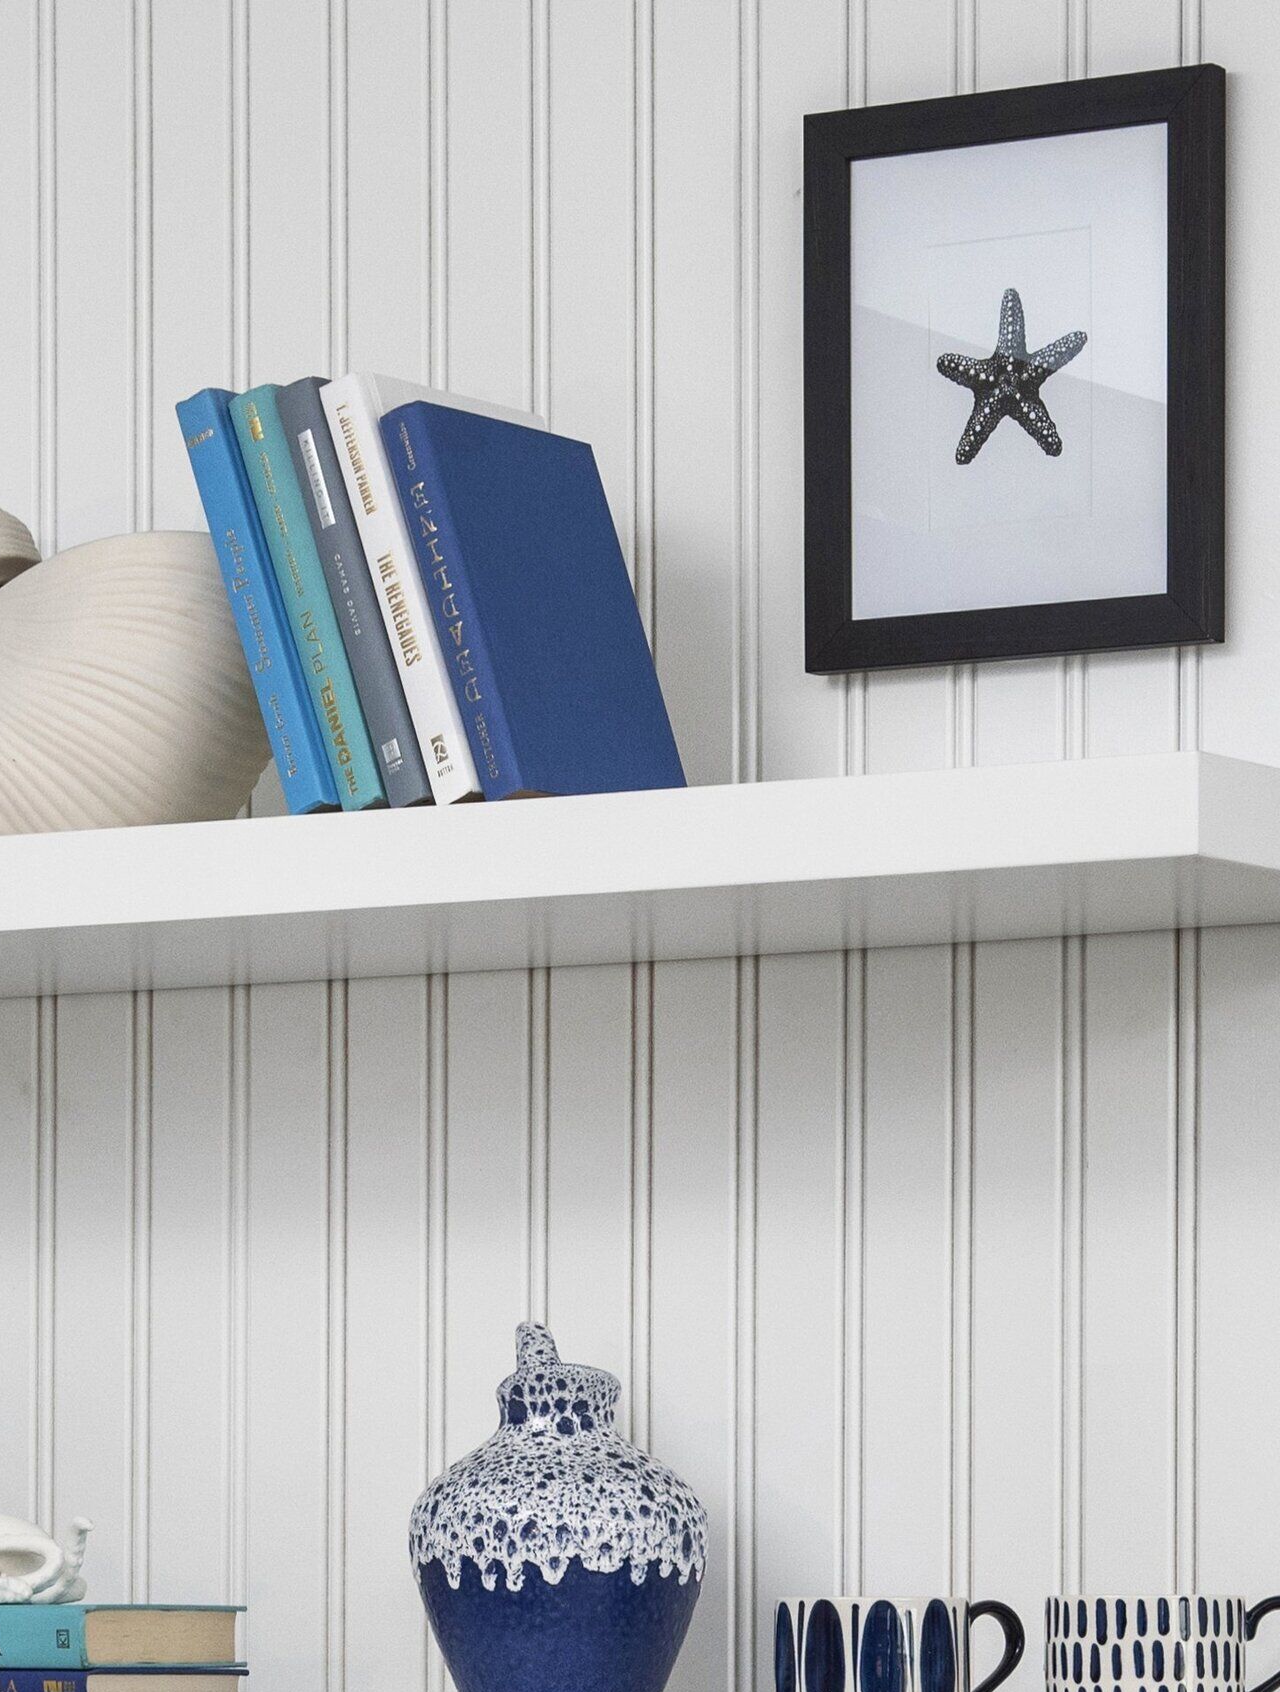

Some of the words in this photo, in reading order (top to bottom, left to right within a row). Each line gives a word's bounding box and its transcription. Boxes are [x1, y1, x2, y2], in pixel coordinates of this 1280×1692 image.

[302, 439, 323, 498] KILLING
[319, 505, 331, 519] IT
[339, 415, 365, 473] JEFFERSON
[356, 474, 377, 515] PARKER
[223, 528, 250, 592] People
[333, 553, 350, 594] CAMAS
[347, 600, 361, 636] DAVIS
[376, 552, 397, 583] THE
[242, 593, 272, 673] Summer
[299, 610, 325, 674] PLAN
[385, 582, 421, 667] RENEGADES
[319, 678, 352, 765] DANIEL
[476, 714, 499, 778] CRUTCHER
[344, 767, 358, 795] THE
